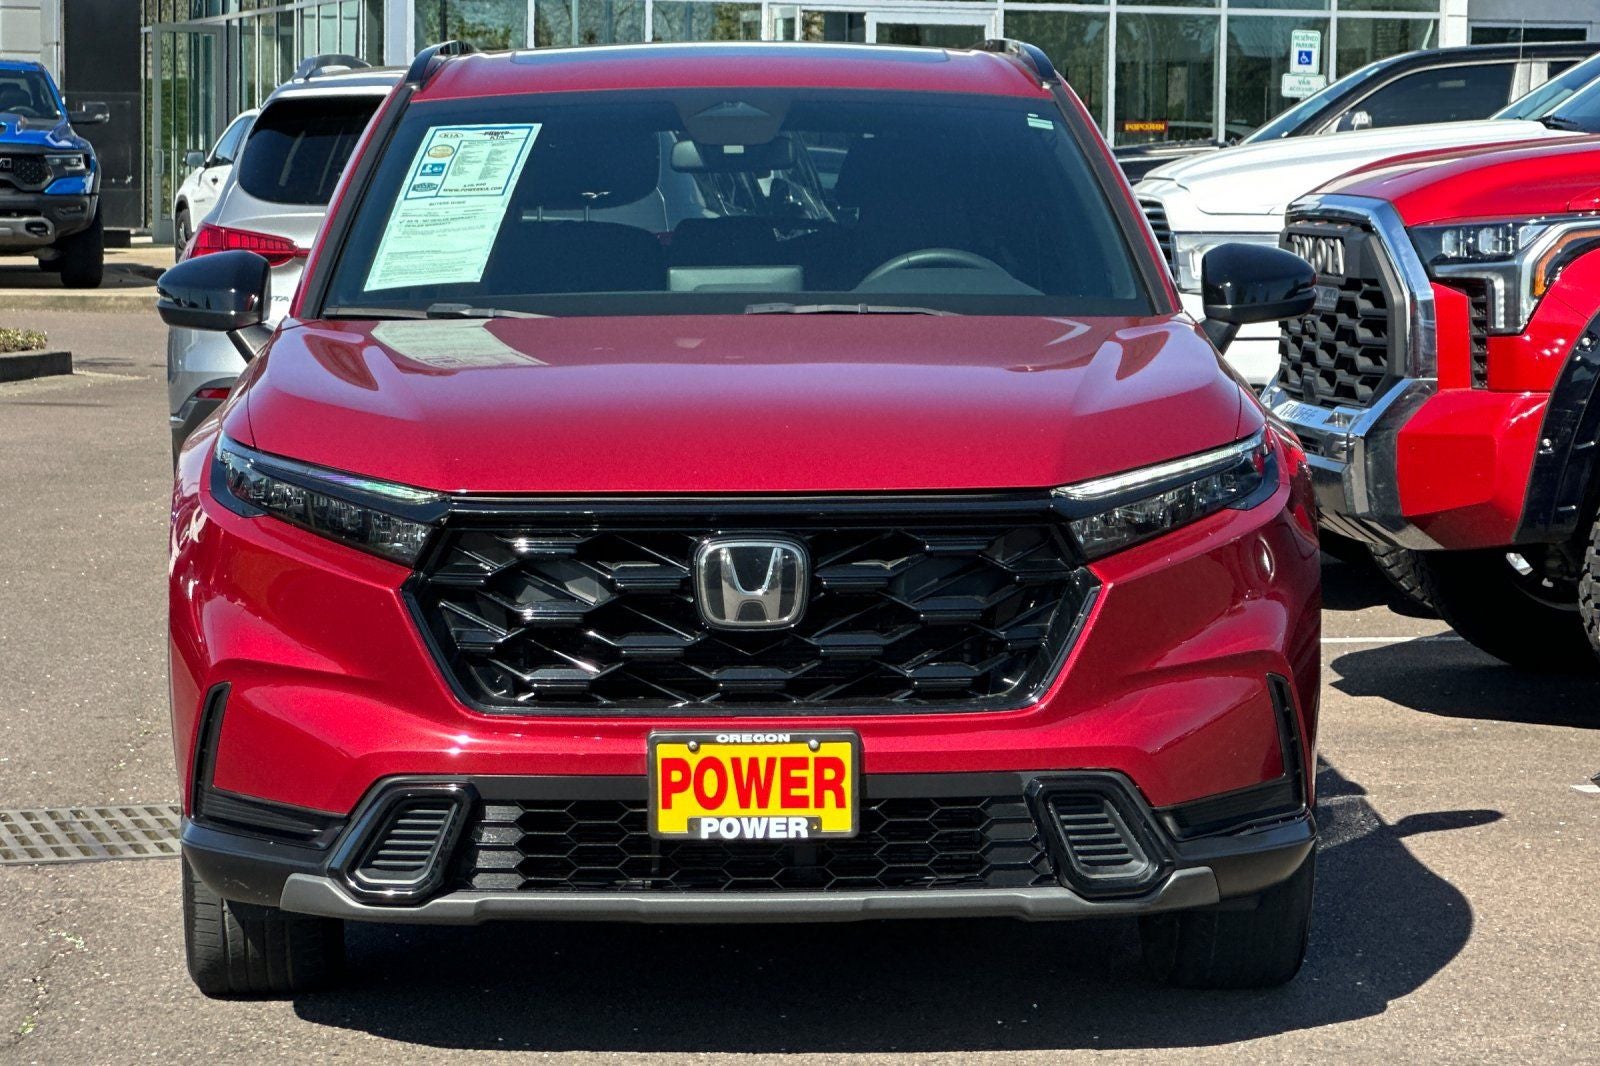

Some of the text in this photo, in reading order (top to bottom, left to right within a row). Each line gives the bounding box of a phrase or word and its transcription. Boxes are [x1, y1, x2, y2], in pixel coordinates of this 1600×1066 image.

[1124, 122, 1165, 131] POPCORN
[715, 733, 791, 743] OREGON
[661, 755, 847, 810] POWER
[699, 817, 809, 839] POWER
